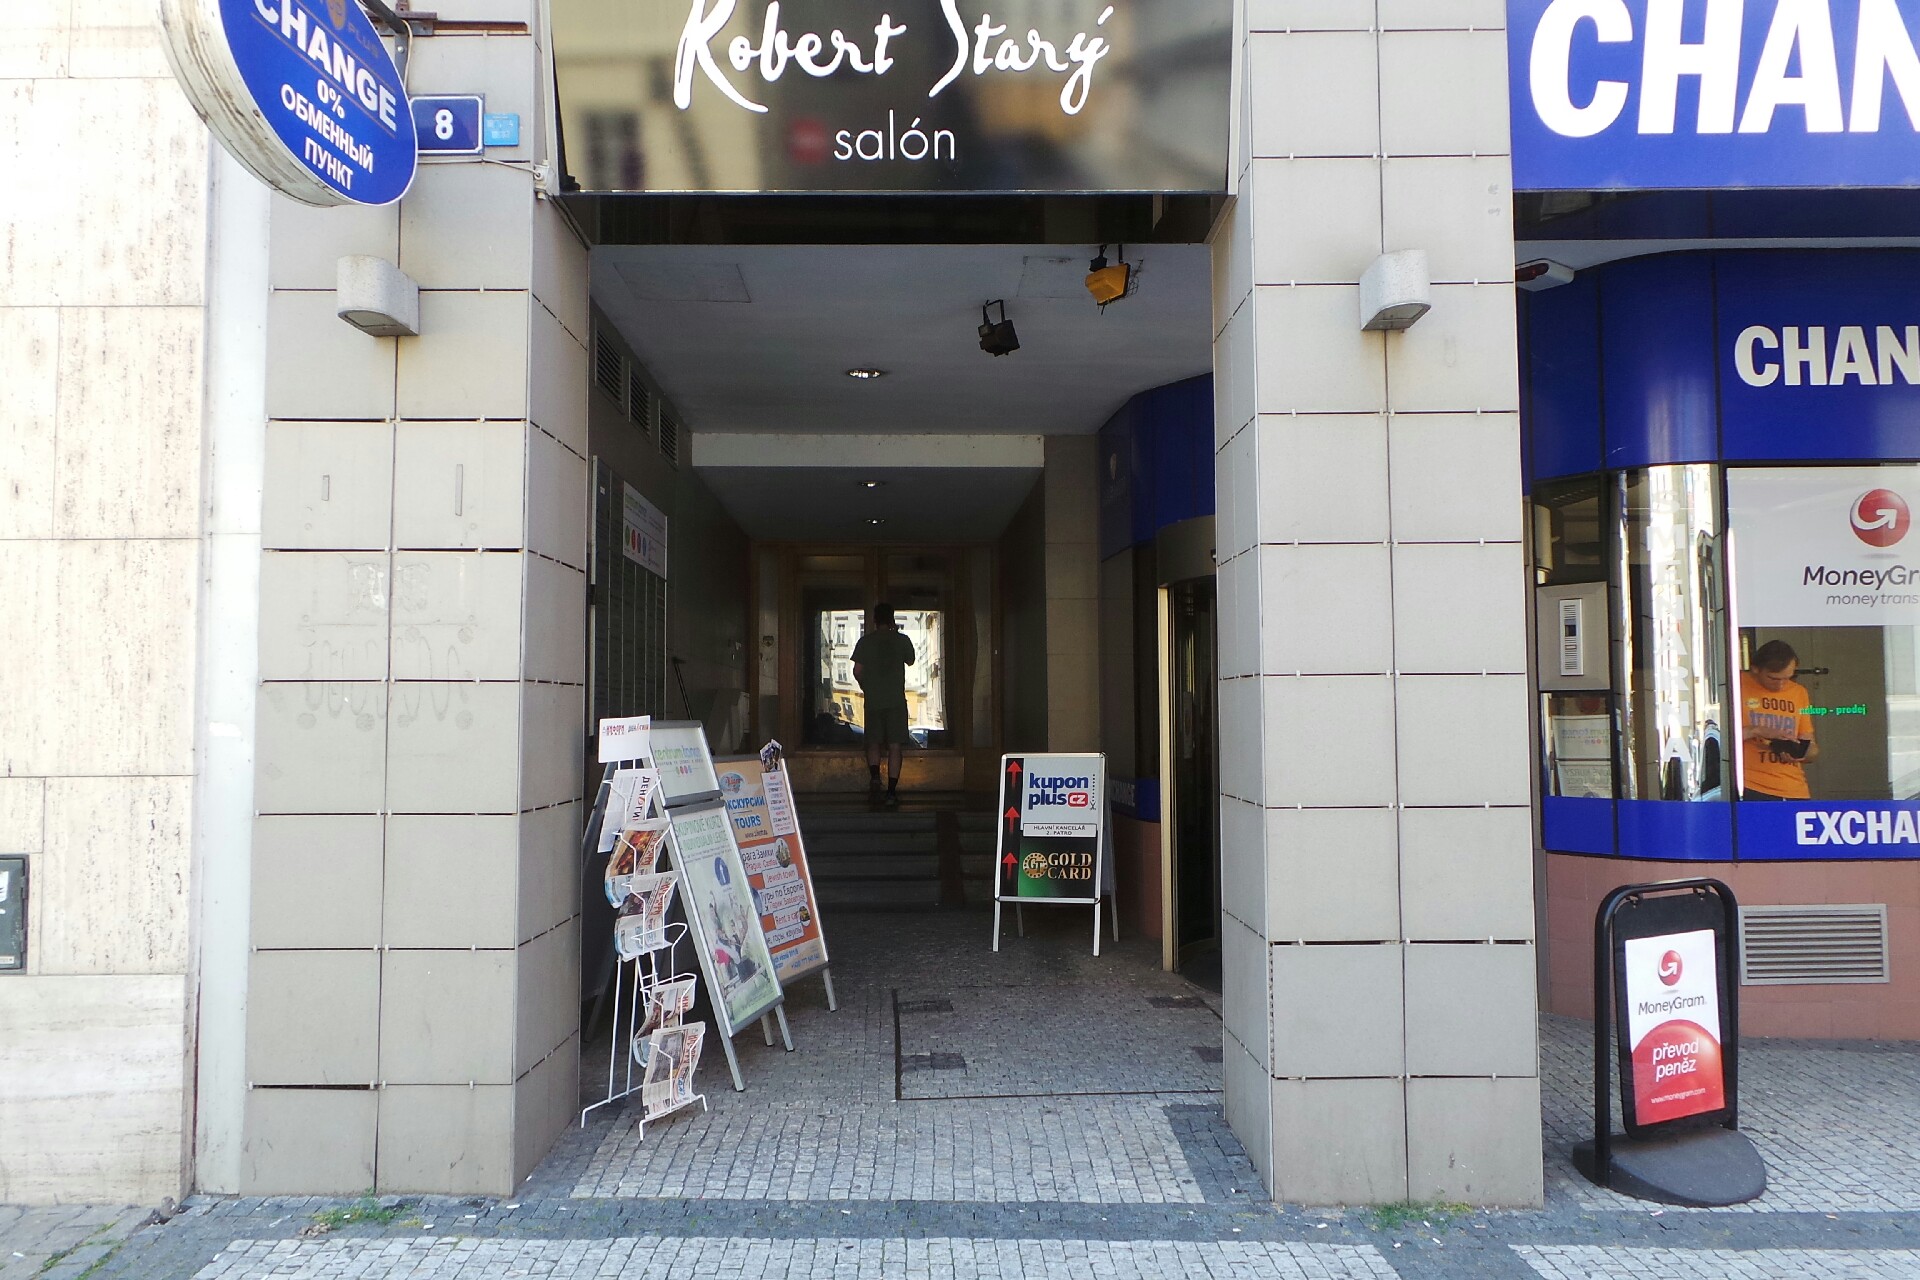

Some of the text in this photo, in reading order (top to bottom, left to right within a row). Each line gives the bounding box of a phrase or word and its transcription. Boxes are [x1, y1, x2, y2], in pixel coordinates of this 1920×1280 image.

[254, 0, 397, 133] CHANGE
[674, 0, 1114, 115] Robert Starý
[316, 79, 346, 119] 0%
[280, 83, 374, 174] ОБМЕННЫЙ
[435, 109, 454, 140] 8
[833, 109, 957, 161] salón
[304, 137, 354, 190] ПУНКТ
[1734, 325, 1920, 387] CHAN
[1803, 564, 1920, 591] MoneyGr
[1826, 592, 1920, 608] money trans
[1762, 697, 1795, 714] GOOD
[1030, 773, 1088, 793] kupon
[727, 795, 766, 811] КСКУРСИИ
[1028, 789, 1067, 810] plus
[734, 815, 762, 830] TOURS
[1796, 810, 1920, 845] EXCHA
[741, 851, 757, 862] рага
[1048, 852, 1092, 867] GOLD
[1047, 867, 1092, 880] CARD
[1638, 995, 1706, 1016] MoneyGram
[1652, 1037, 1699, 1065] převod
[1655, 1057, 1697, 1082] peněz
